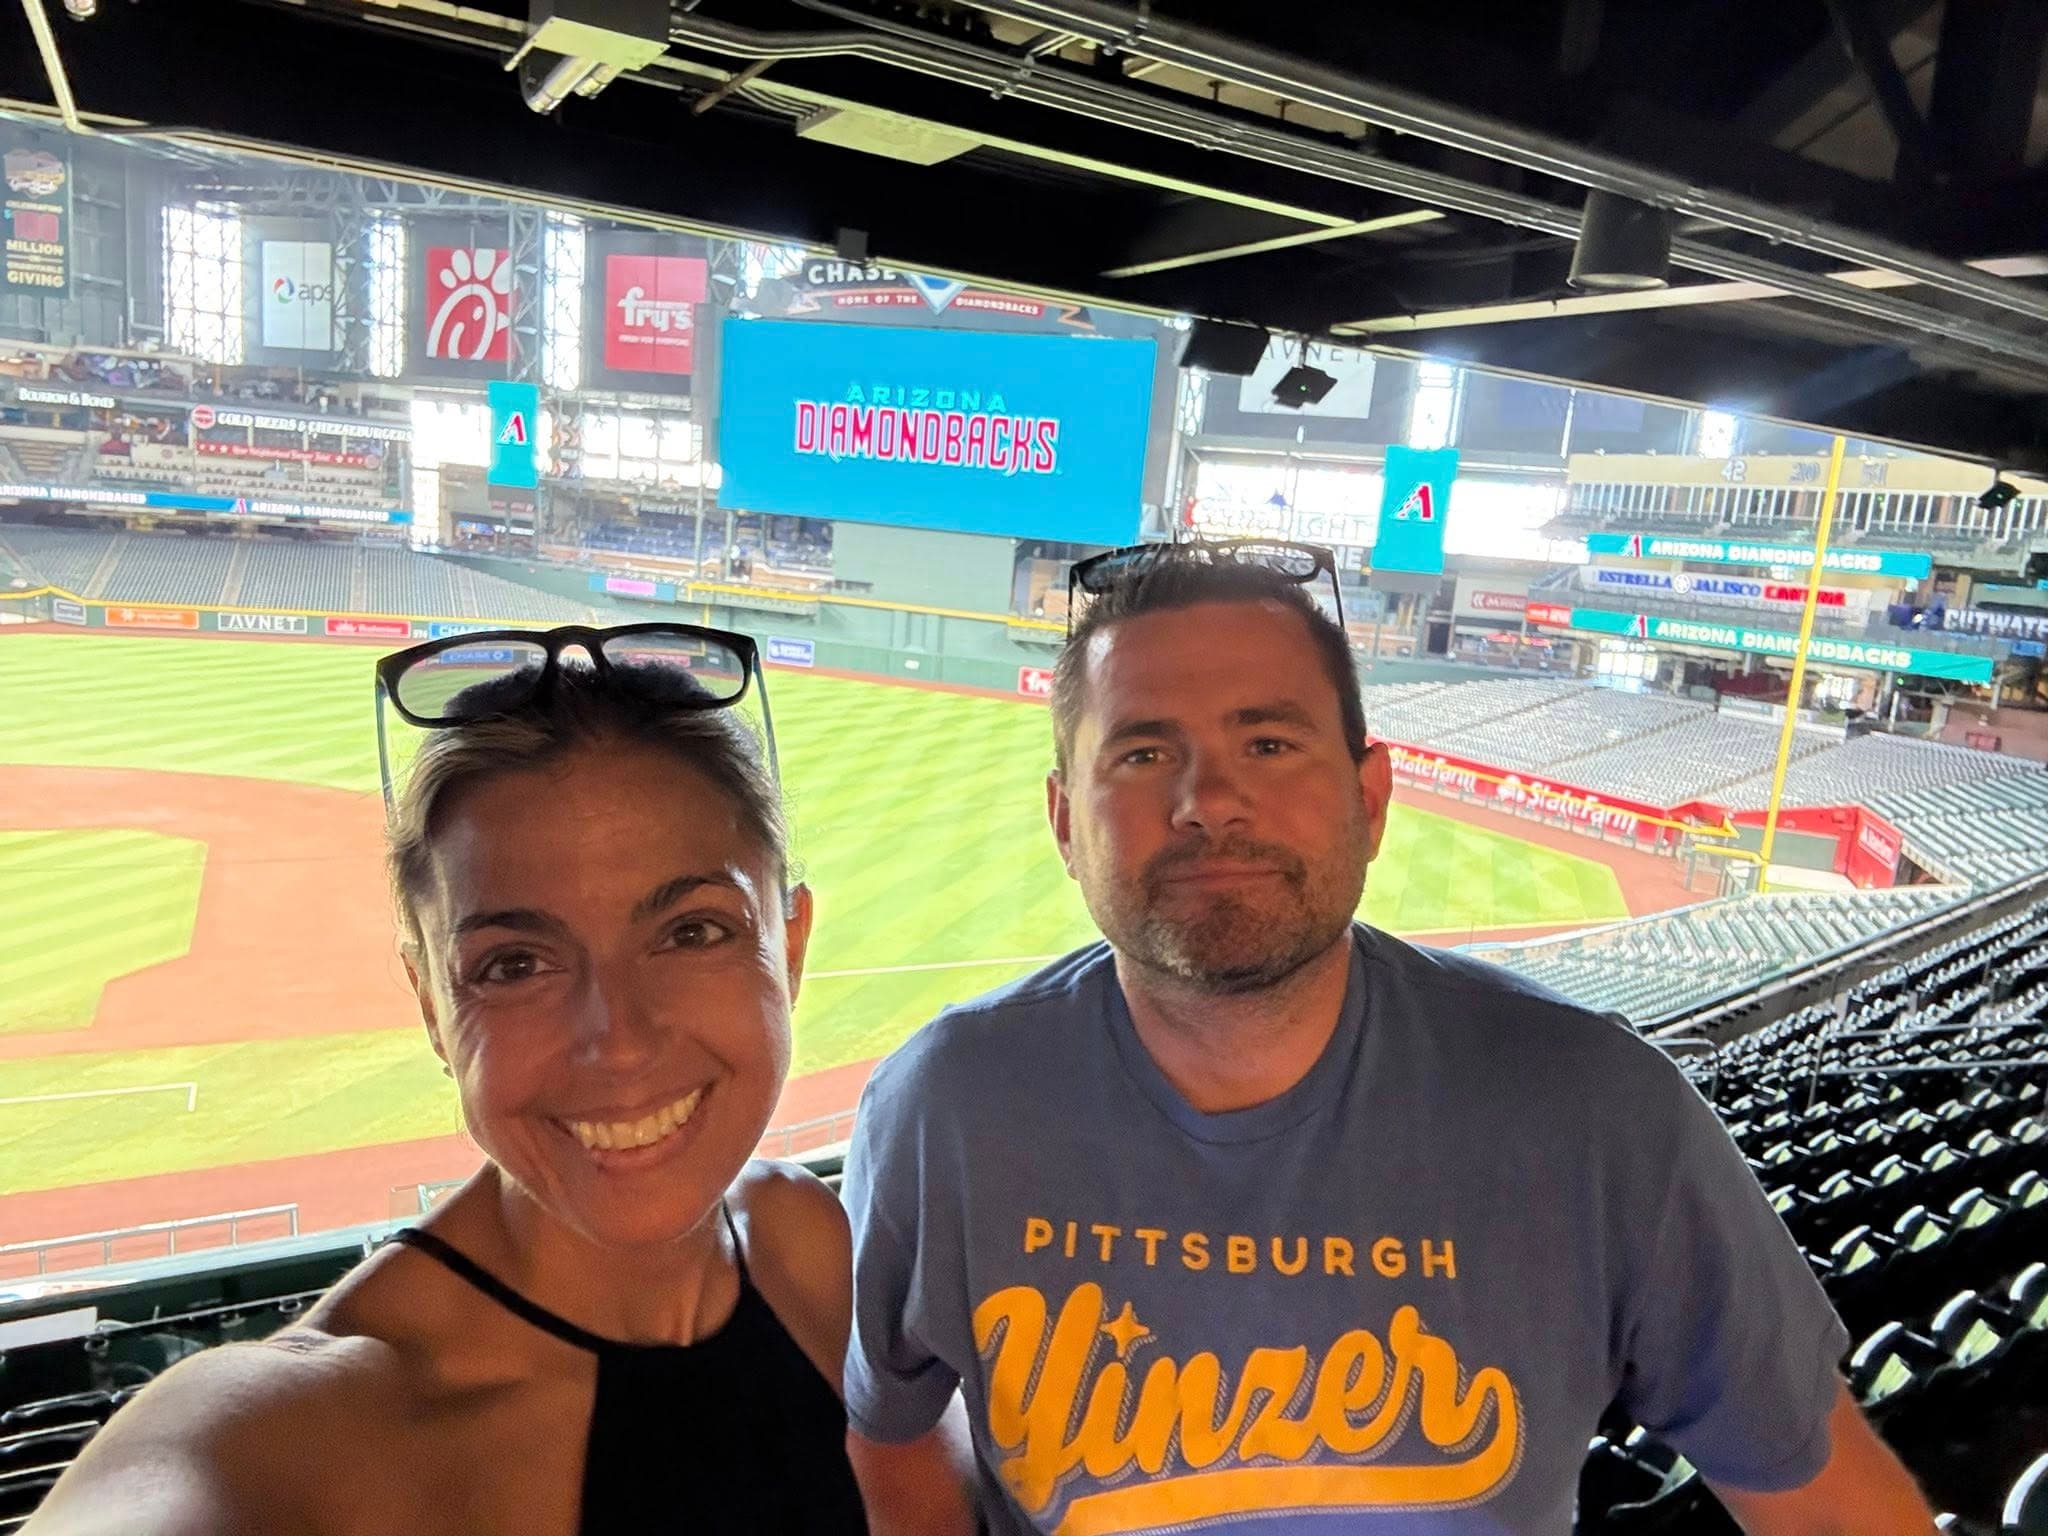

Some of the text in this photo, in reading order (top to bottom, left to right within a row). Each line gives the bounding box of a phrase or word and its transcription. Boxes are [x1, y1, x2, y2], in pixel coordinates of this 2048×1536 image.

[6, 239, 64, 256] MILLION
[7, 269, 65, 288] GIVING
[299, 284, 332, 306] aps
[838, 295, 1039, 315] HOME OF THE DIAMONDBACKS
[616, 286, 694, 333] fry's
[847, 383, 1008, 413] ARIZONA
[217, 412, 254, 427] COLD
[254, 415, 297, 431] BEERS
[794, 399, 1062, 477] DIAMONDBACKS
[1720, 459, 1747, 482] 42
[50, 487, 147, 505] DIAMONDBACKS
[252, 501, 301, 515] ARIZONA
[302, 505, 390, 522] DIAMONDBACKS
[1649, 540, 1724, 560] ARIZONA
[1598, 570, 1846, 606] ESTRELLA JALISCO CANTNA
[228, 614, 298, 632] AVNET
[1656, 621, 1737, 646] ARIZONA
[1024, 1217, 1457, 1279] PITTSBURGH
[971, 1282, 1524, 1518] Yinzer
